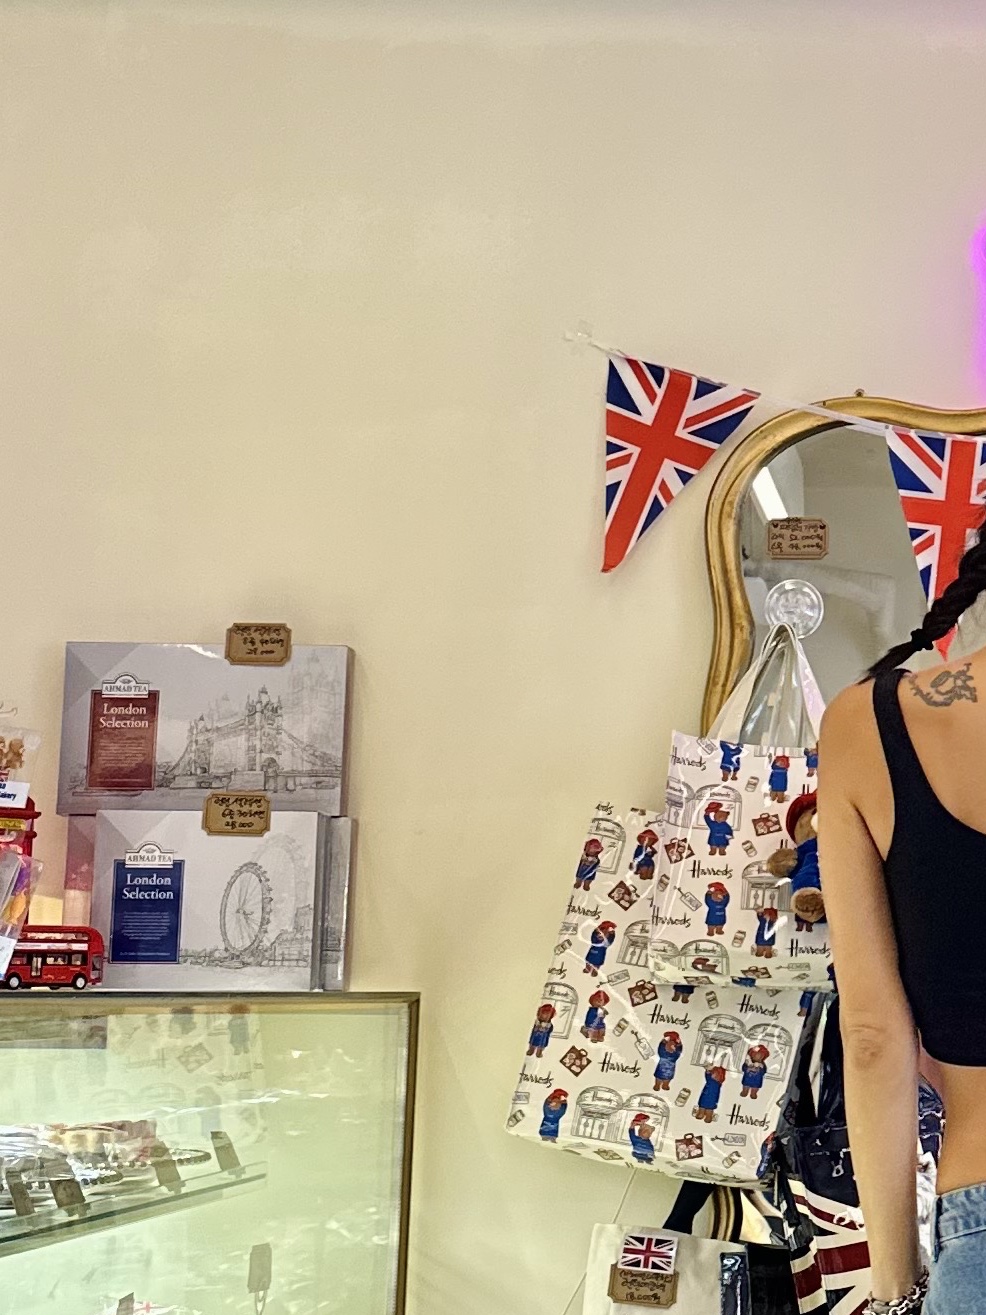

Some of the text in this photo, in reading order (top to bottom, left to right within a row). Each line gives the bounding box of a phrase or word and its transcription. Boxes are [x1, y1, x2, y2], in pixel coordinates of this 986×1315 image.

[103, 685, 148, 693] AHMAD TEA
[103, 703, 147, 715] London
[100, 716, 149, 728] Selection
[670, 744, 707, 771] Harrods
[127, 855, 172, 863] AHMAD TEA
[688, 859, 734, 879] Harrods
[126, 873, 172, 886] London
[122, 887, 174, 900] Selection
[650, 905, 692, 928] Harrods
[785, 938, 831, 958] Harrods
[648, 1003, 692, 1030] Harrods
[736, 993, 781, 1020] Harrods
[598, 1051, 642, 1078] Harrods
[726, 1103, 771, 1131] Harrods
